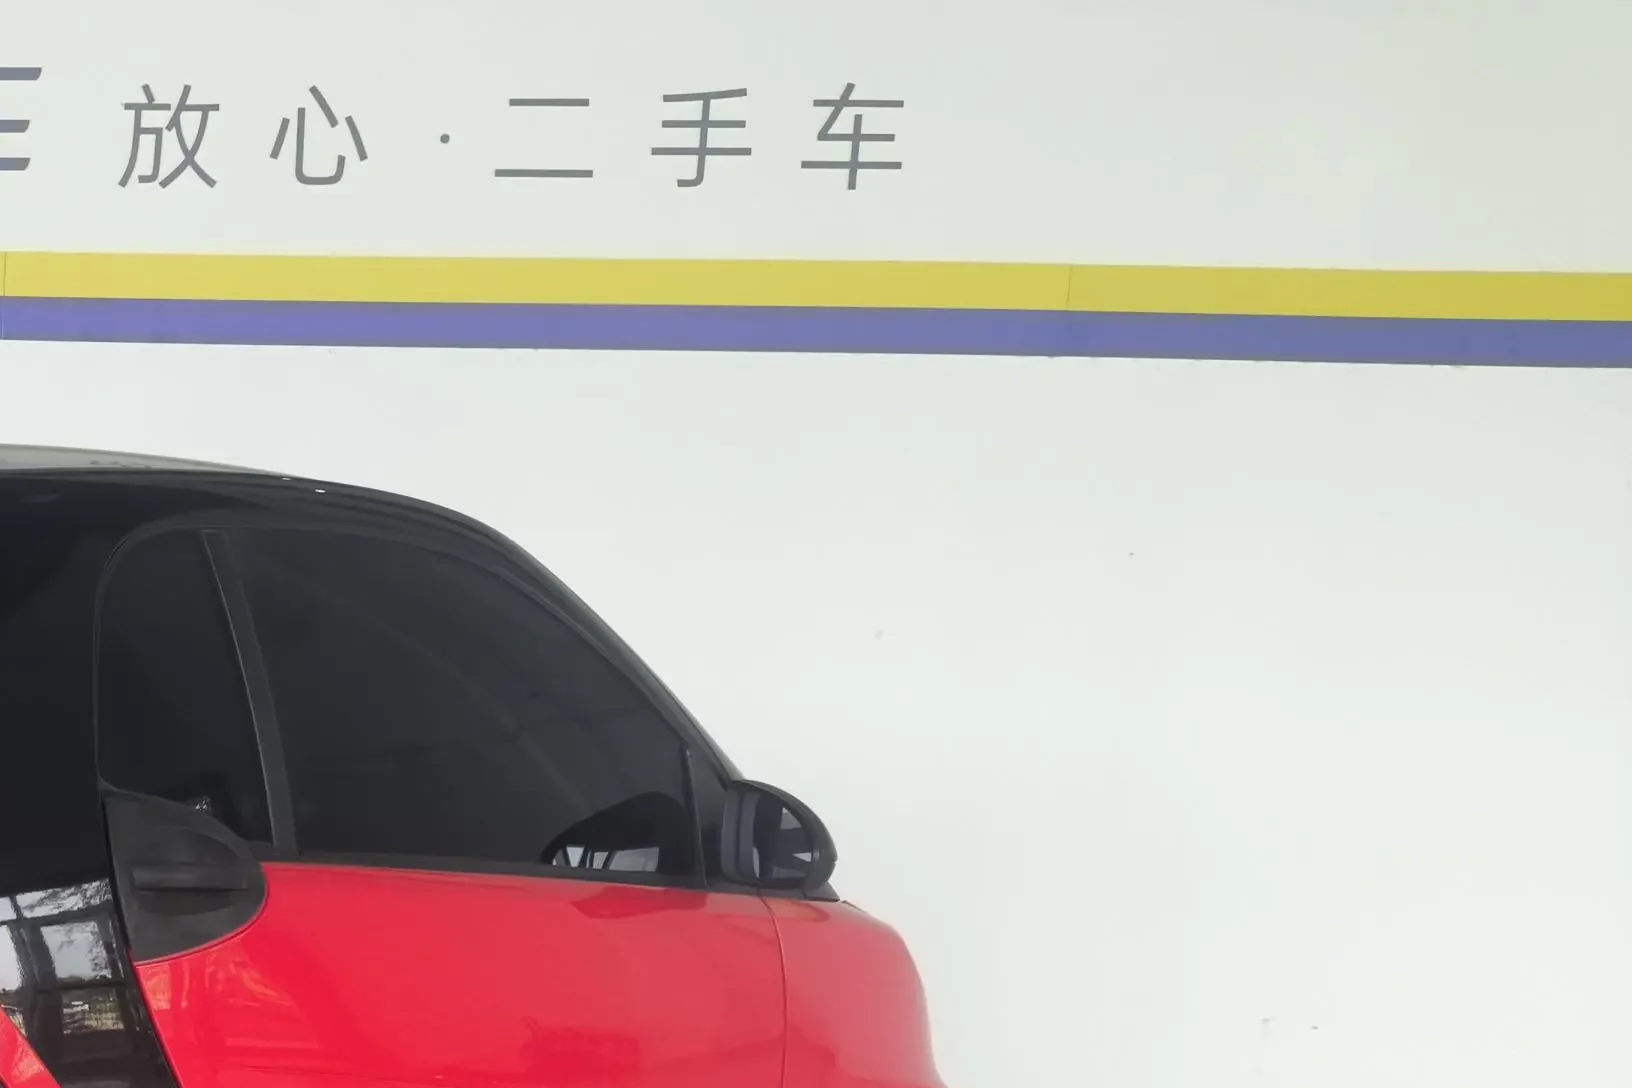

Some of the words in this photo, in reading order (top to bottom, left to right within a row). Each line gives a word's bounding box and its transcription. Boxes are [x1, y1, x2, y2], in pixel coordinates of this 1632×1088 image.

[118, 82, 905, 190] 放心·二手车
